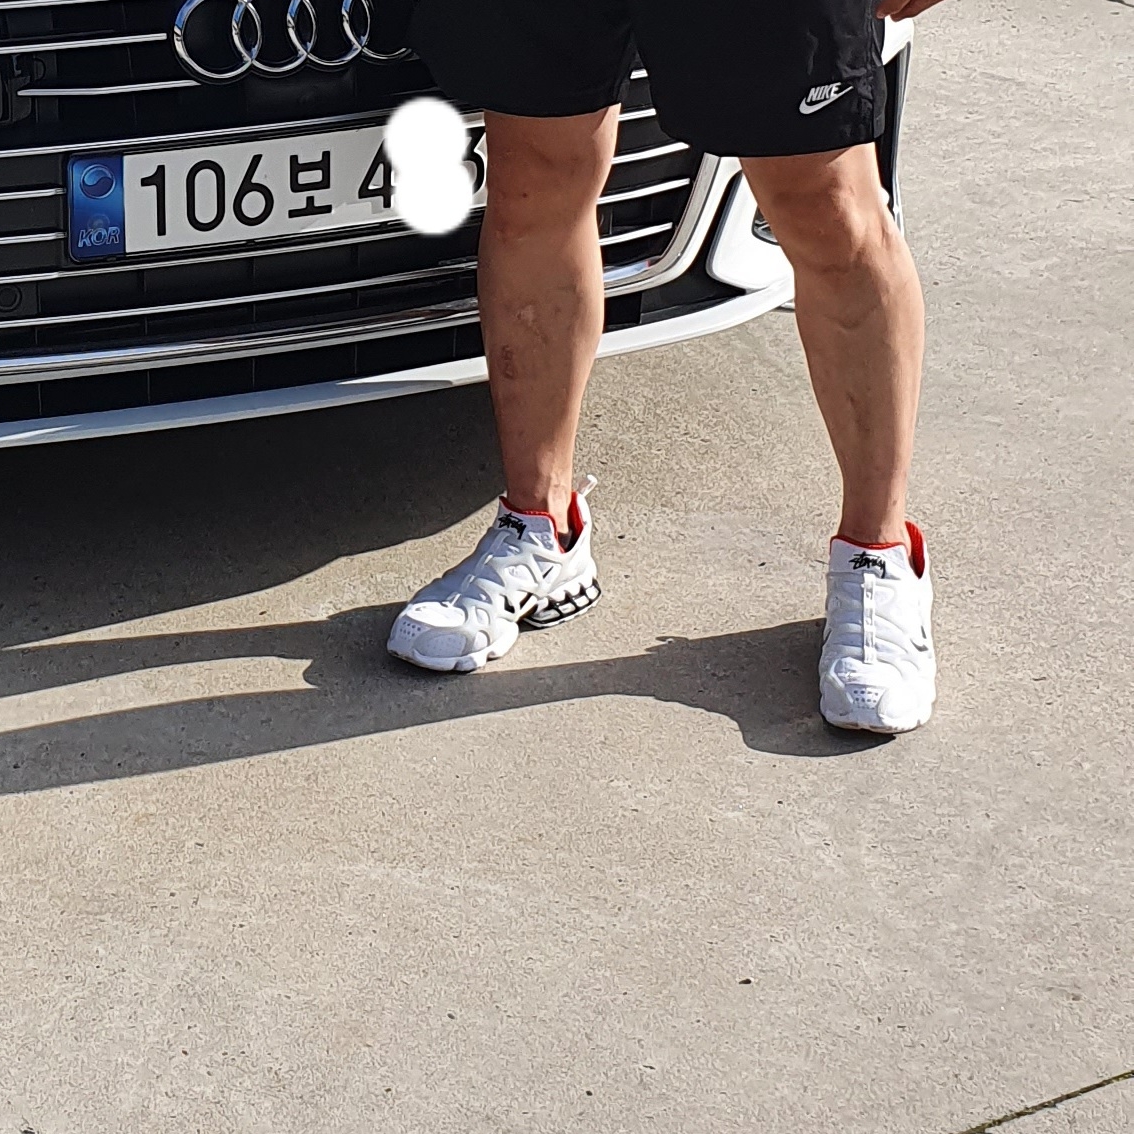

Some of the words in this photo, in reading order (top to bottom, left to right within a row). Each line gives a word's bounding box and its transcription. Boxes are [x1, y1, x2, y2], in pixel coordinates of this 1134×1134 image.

[806, 82, 842, 103] NIKE
[140, 150, 333, 237] 106보
[78, 226, 121, 249] KOR
